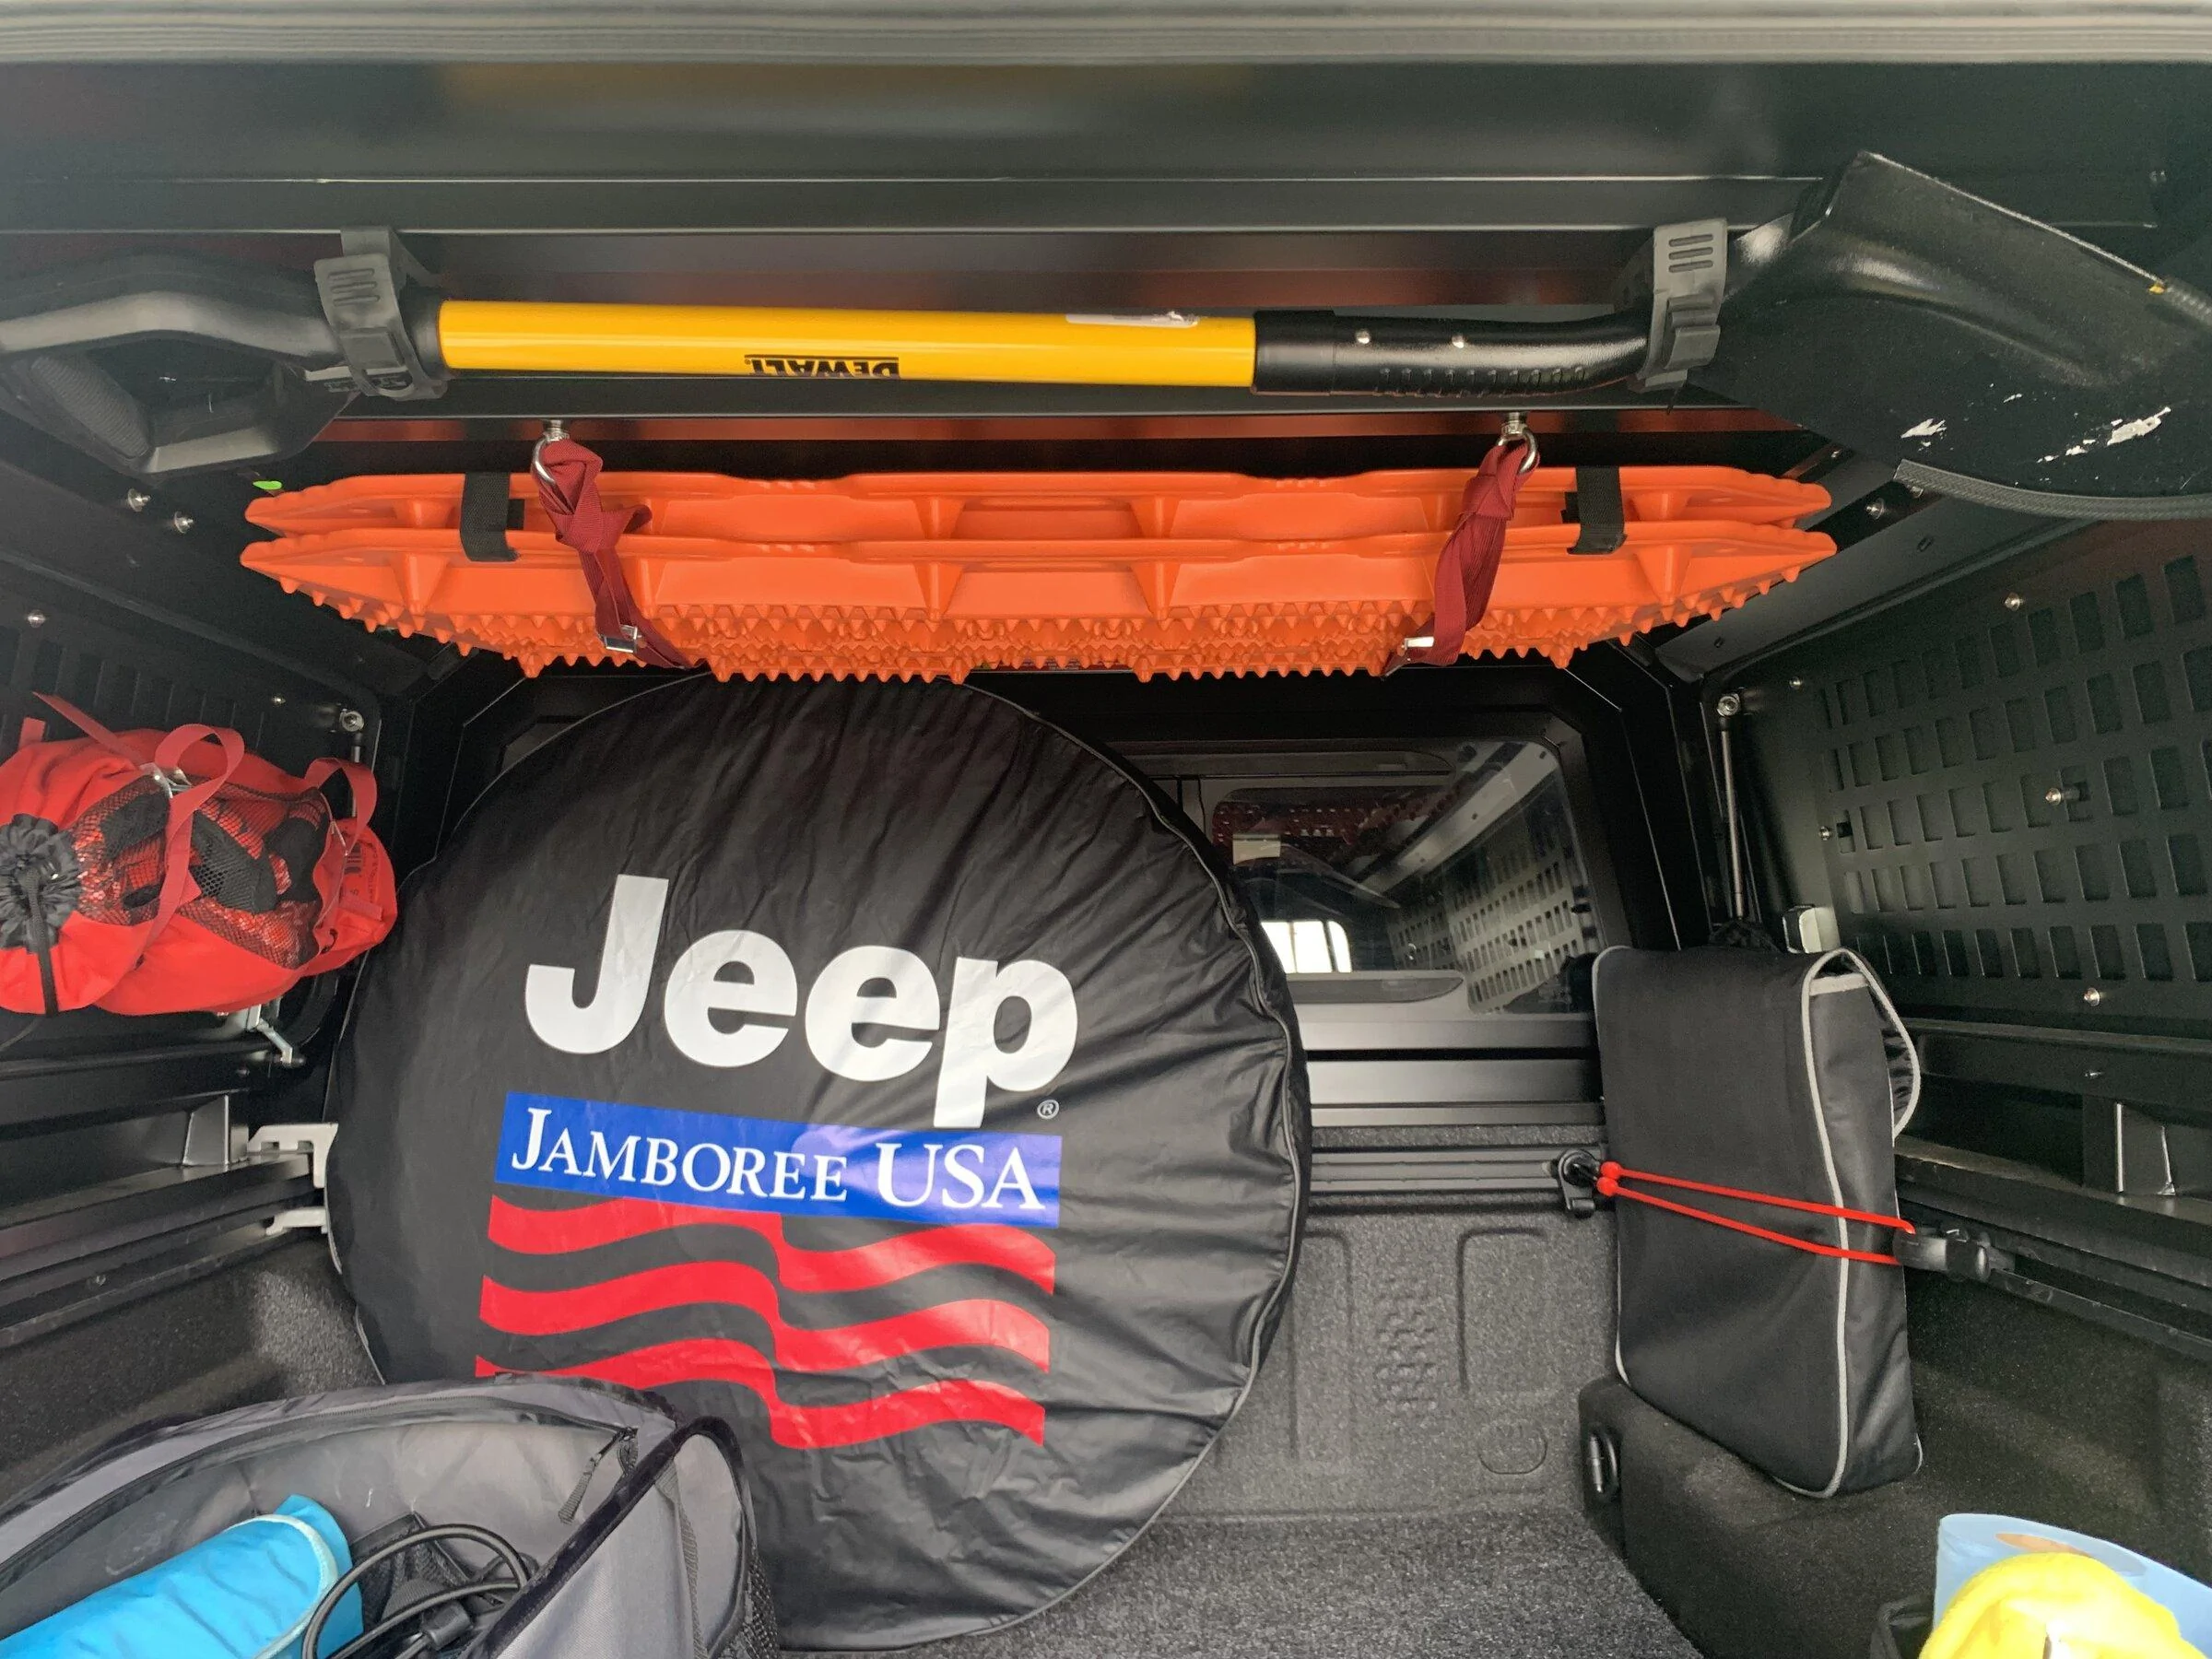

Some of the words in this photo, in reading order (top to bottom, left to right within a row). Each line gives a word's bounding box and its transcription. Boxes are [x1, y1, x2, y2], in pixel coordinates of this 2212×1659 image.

[747, 359, 900, 379] DEWALT
[525, 874, 1077, 1128] Jeep
[512, 1107, 848, 1201] JAMBOREE
[876, 1143, 1046, 1209] USA
